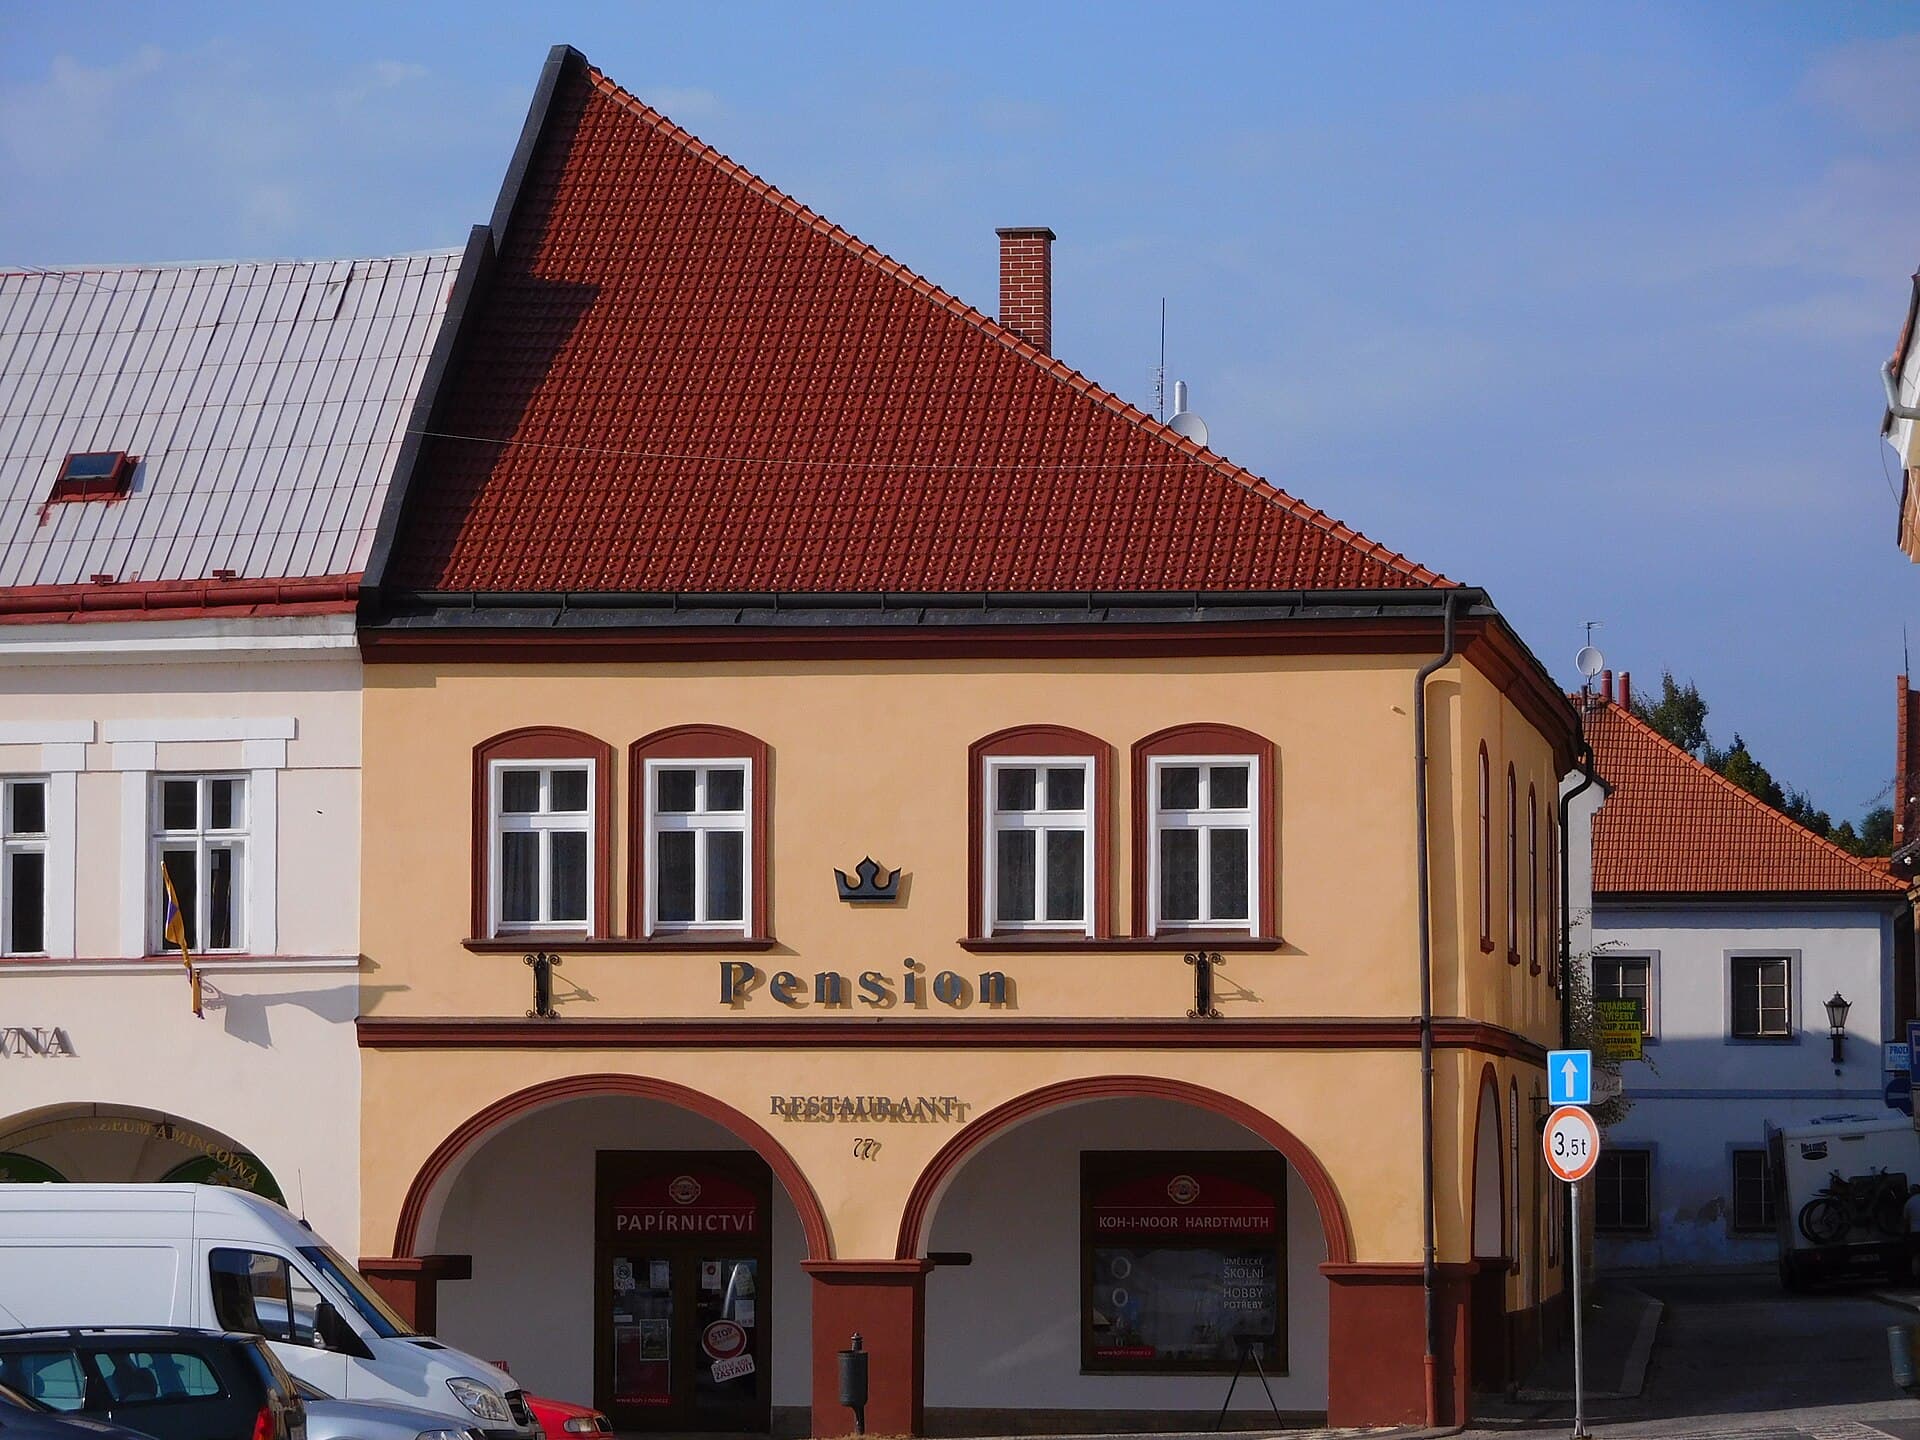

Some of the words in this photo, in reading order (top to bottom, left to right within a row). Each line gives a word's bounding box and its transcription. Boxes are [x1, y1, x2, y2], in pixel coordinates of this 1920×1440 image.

[719, 957, 1007, 1005] Pension
[770, 1095, 959, 1116] RESTAURANT
[171, 1126, 258, 1189] MINCOVNA
[616, 1209, 756, 1232] PAPÍRNICTVÍ
[1098, 1215, 1179, 1229] KOH-I-NOOR
[1185, 1215, 1270, 1229] HARDTMUTH
[1223, 1265, 1265, 1279] ŠKOLNÍ
[1223, 1287, 1264, 1298] HOBBY
[1223, 1299, 1264, 1310] POTŘEBY
[711, 1327, 733, 1341] STOP
